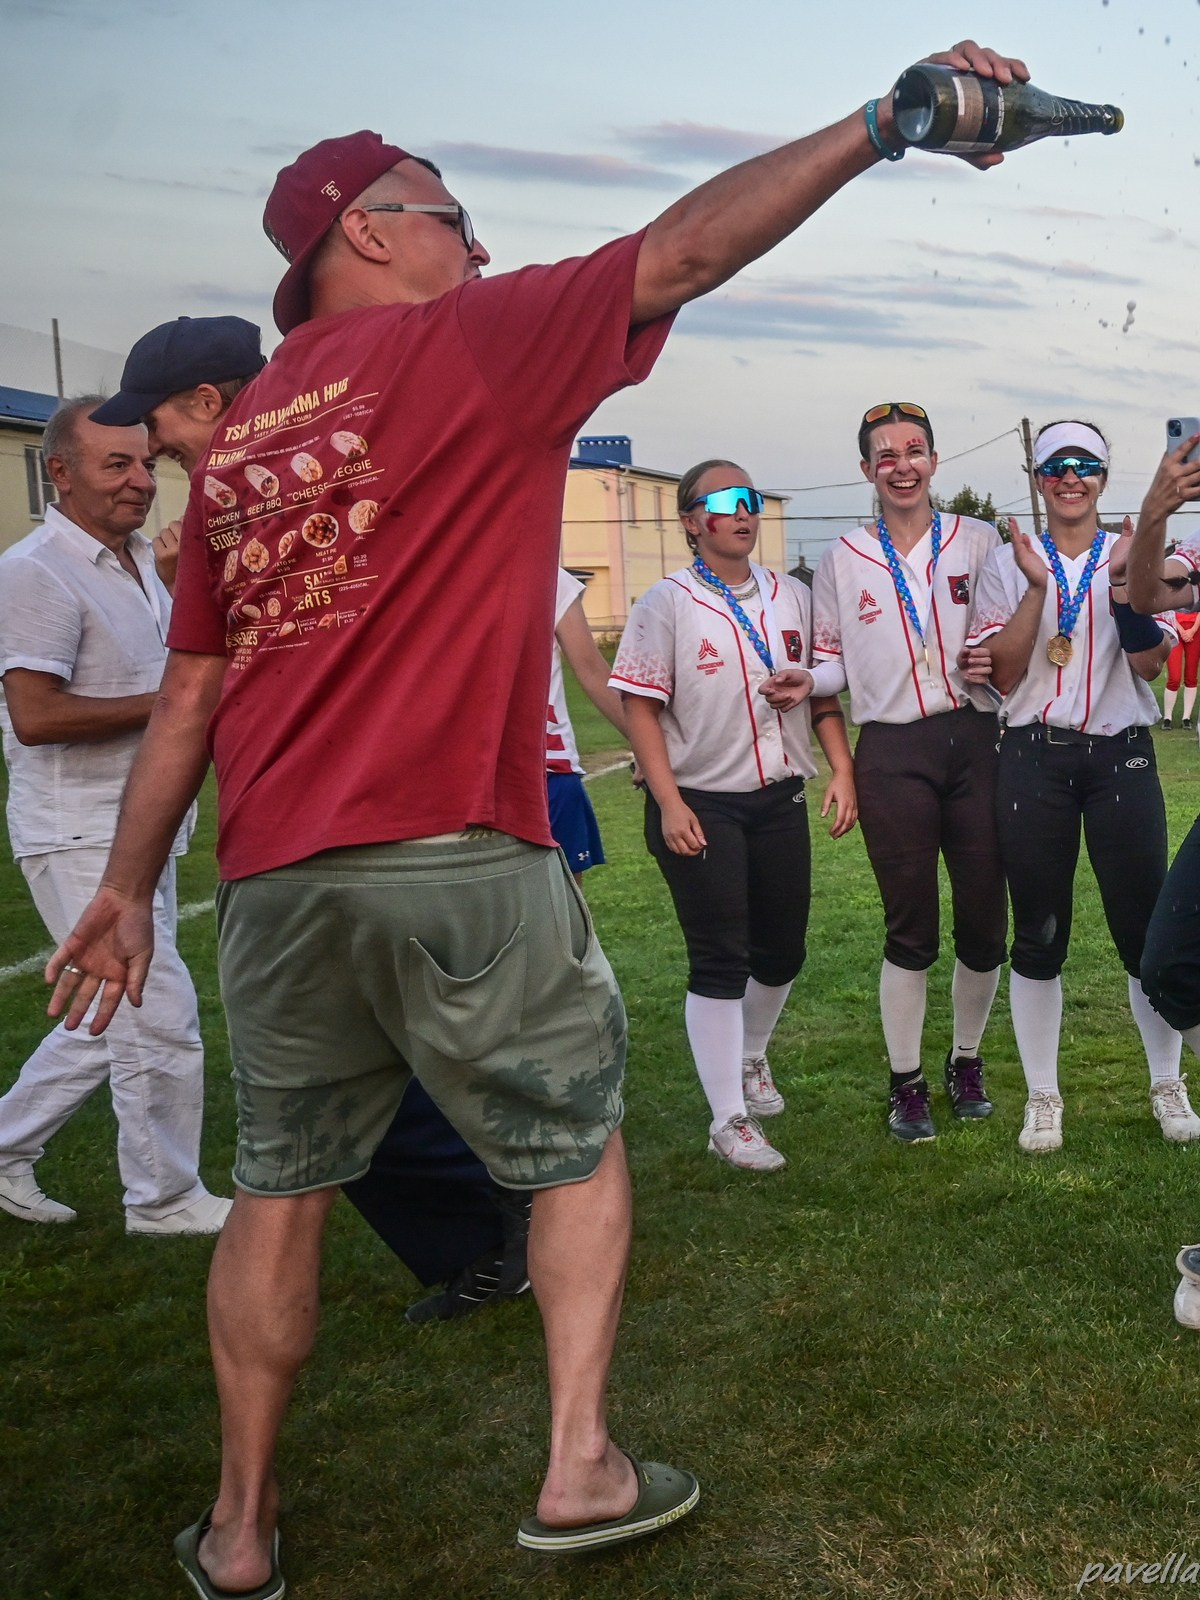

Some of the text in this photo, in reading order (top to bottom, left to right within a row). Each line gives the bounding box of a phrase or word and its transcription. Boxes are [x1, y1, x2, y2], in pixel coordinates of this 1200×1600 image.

[323, 376, 350, 403] HUB
[247, 497, 282, 517] BEEF BBQ
[207, 511, 241, 529] CHICKEN
[210, 530, 242, 552] SIDES
[656, 1502, 691, 1527] crocs
